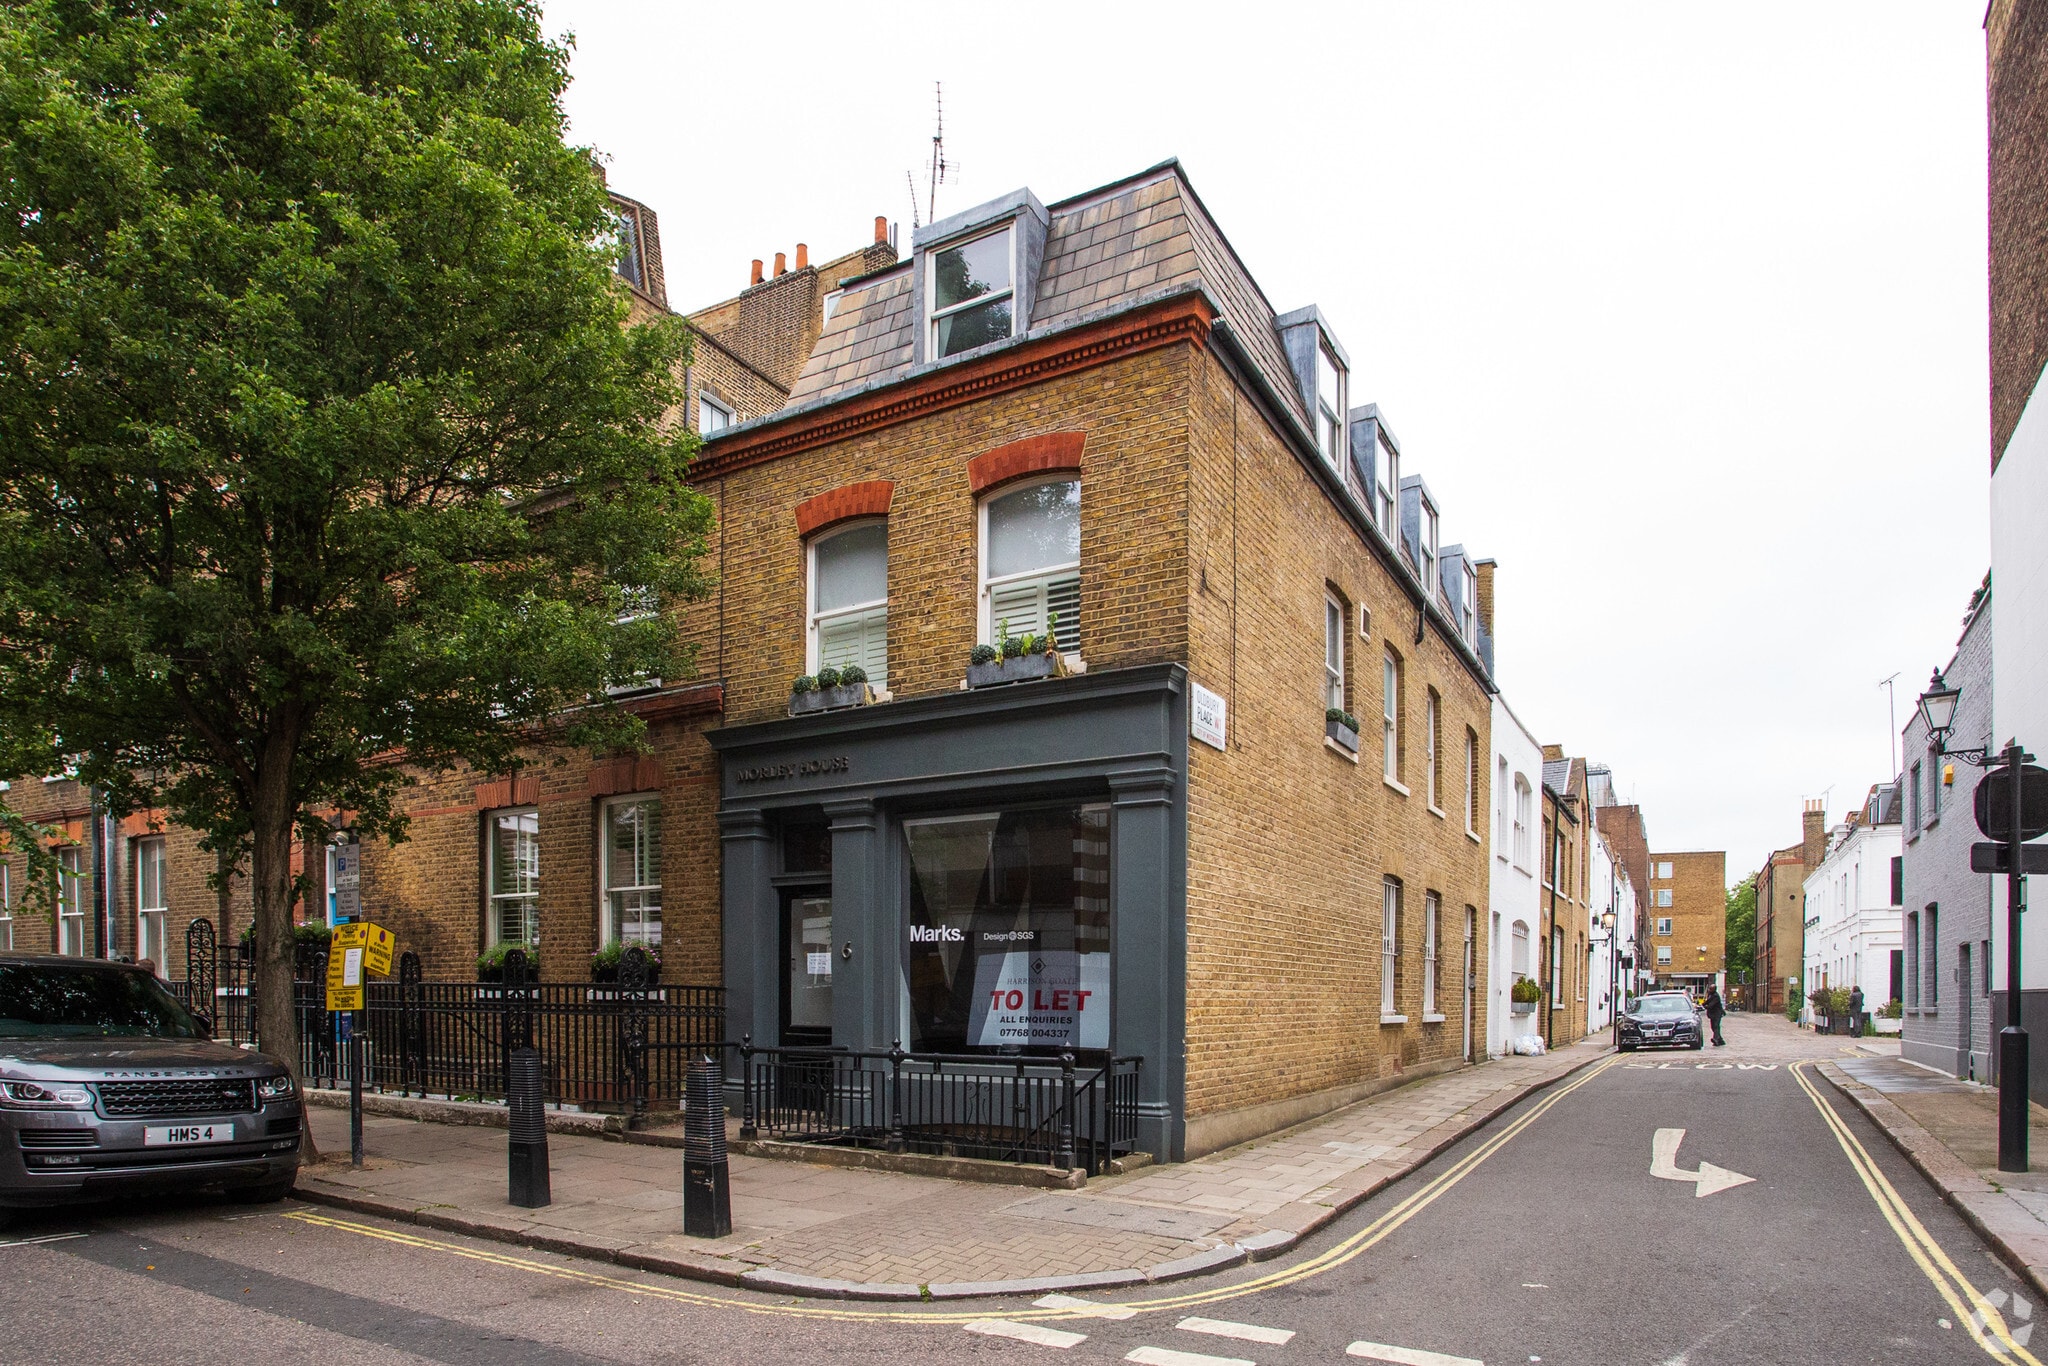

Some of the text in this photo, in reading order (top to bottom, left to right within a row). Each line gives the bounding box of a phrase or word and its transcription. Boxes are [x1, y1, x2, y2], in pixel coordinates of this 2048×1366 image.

[1197, 706, 1213, 726] PLACE
[737, 757, 849, 781] MORLEY HOUSE
[909, 924, 965, 942] Marks.
[368, 946, 391, 961] WARNING
[842, 940, 852, 959] 6
[990, 989, 1092, 1011] TO LET
[1000, 1015, 1073, 1025] ALL ENQUIRIES
[1000, 1028, 1070, 1038] 07768 004337
[104, 1069, 245, 1078] RANGE ROVER
[1622, 1063, 1779, 1071] SLOW
[168, 1126, 214, 1142] HMS 4
